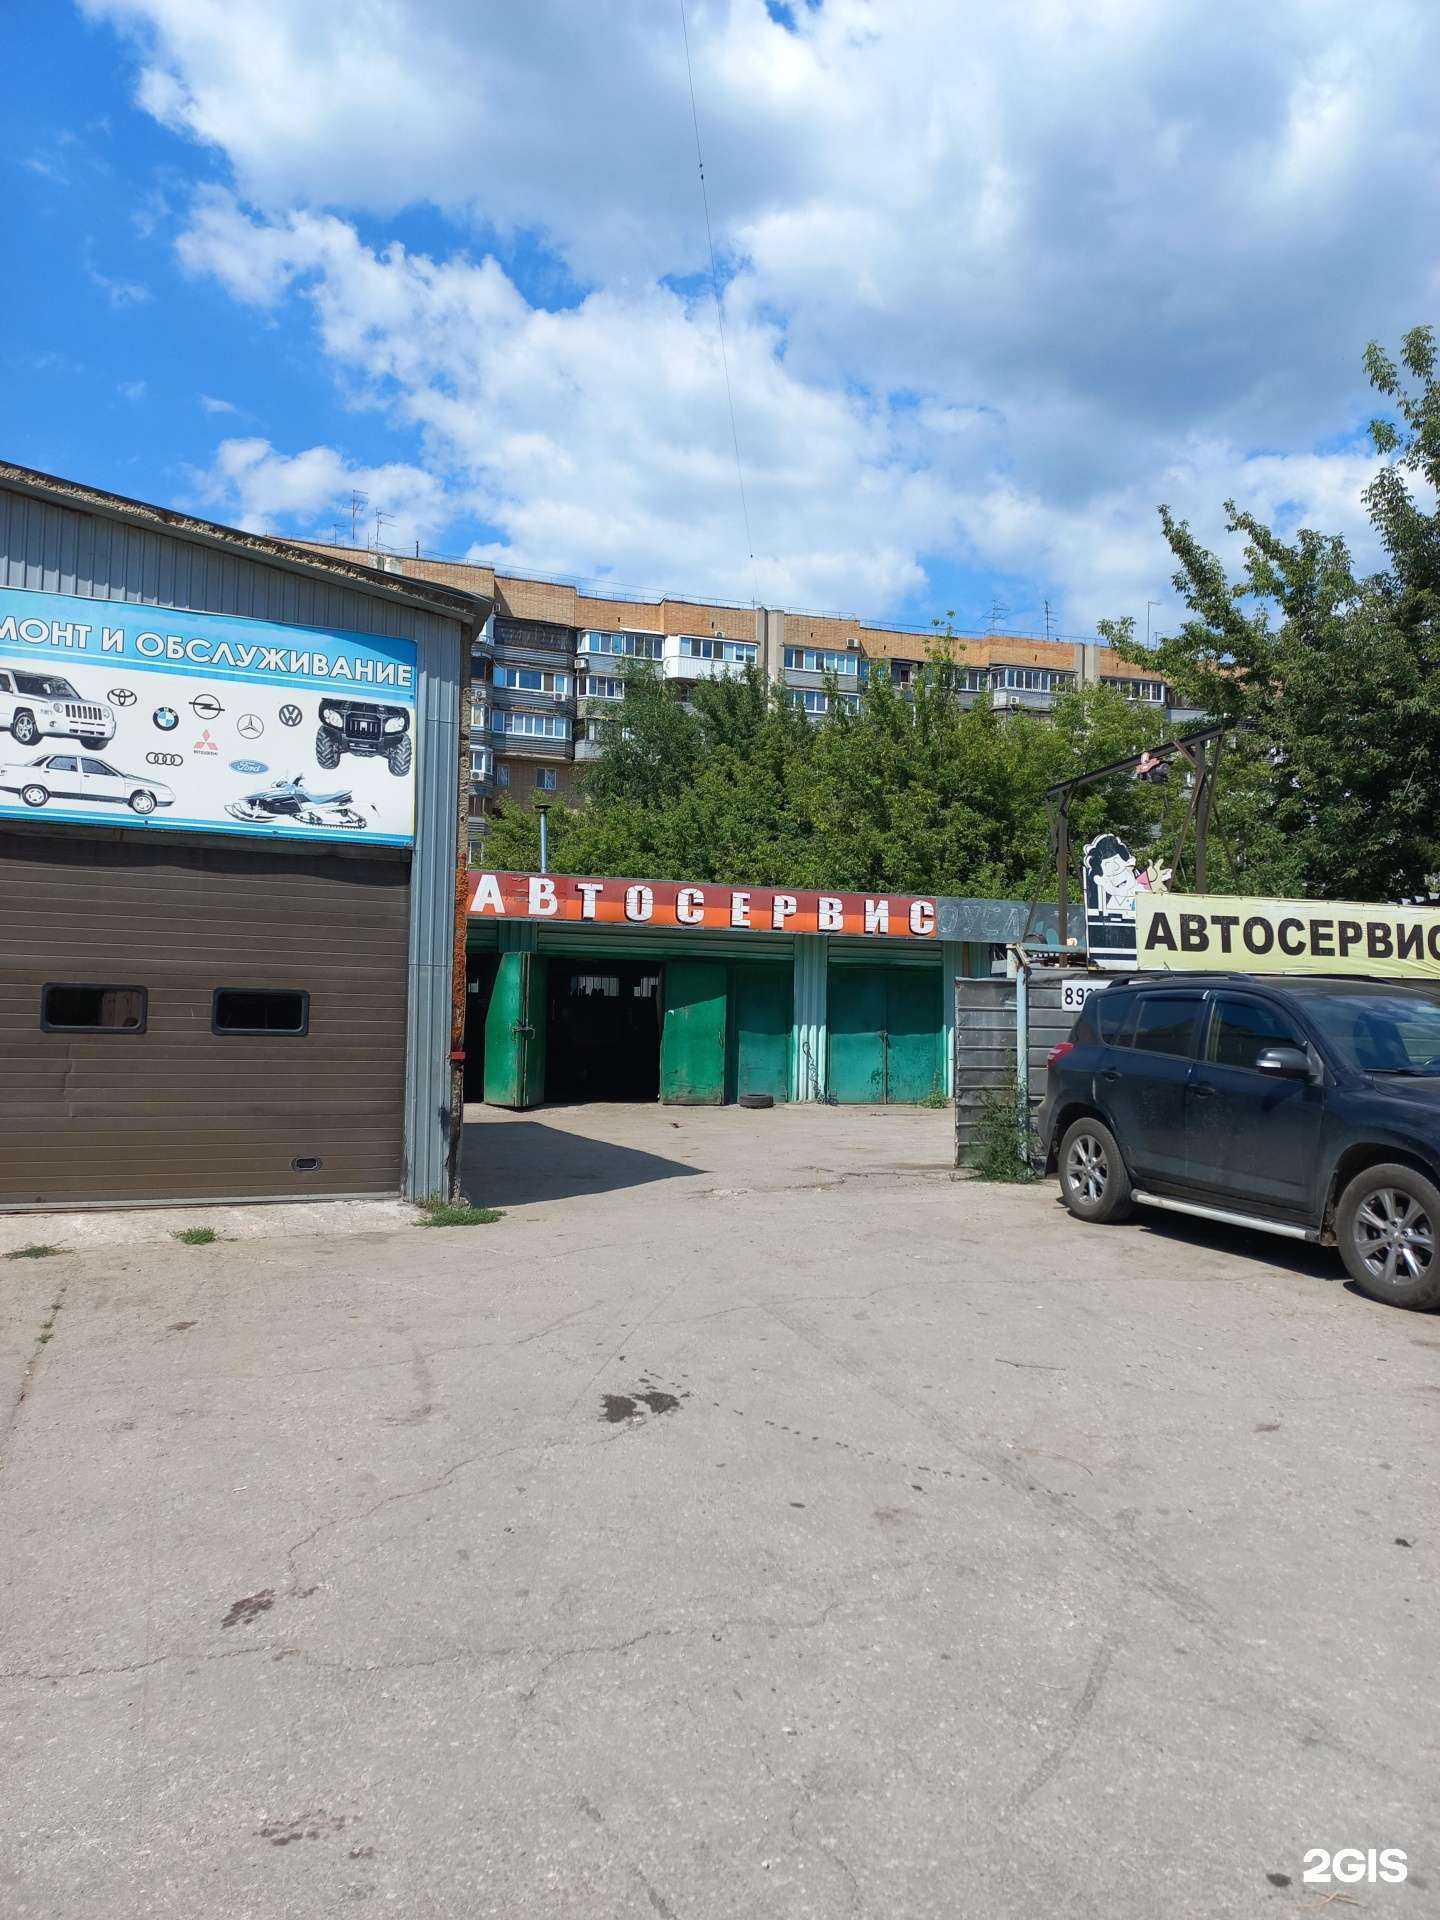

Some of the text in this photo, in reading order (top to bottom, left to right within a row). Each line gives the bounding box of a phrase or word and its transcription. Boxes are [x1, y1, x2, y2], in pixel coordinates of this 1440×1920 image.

[101, 627, 125, 653] И
[135, 631, 412, 687] ОБСЛУЖИВАНИЕ
[469, 874, 935, 936] АВТОСЕРВИС
[1065, 987, 1094, 1005] 89
